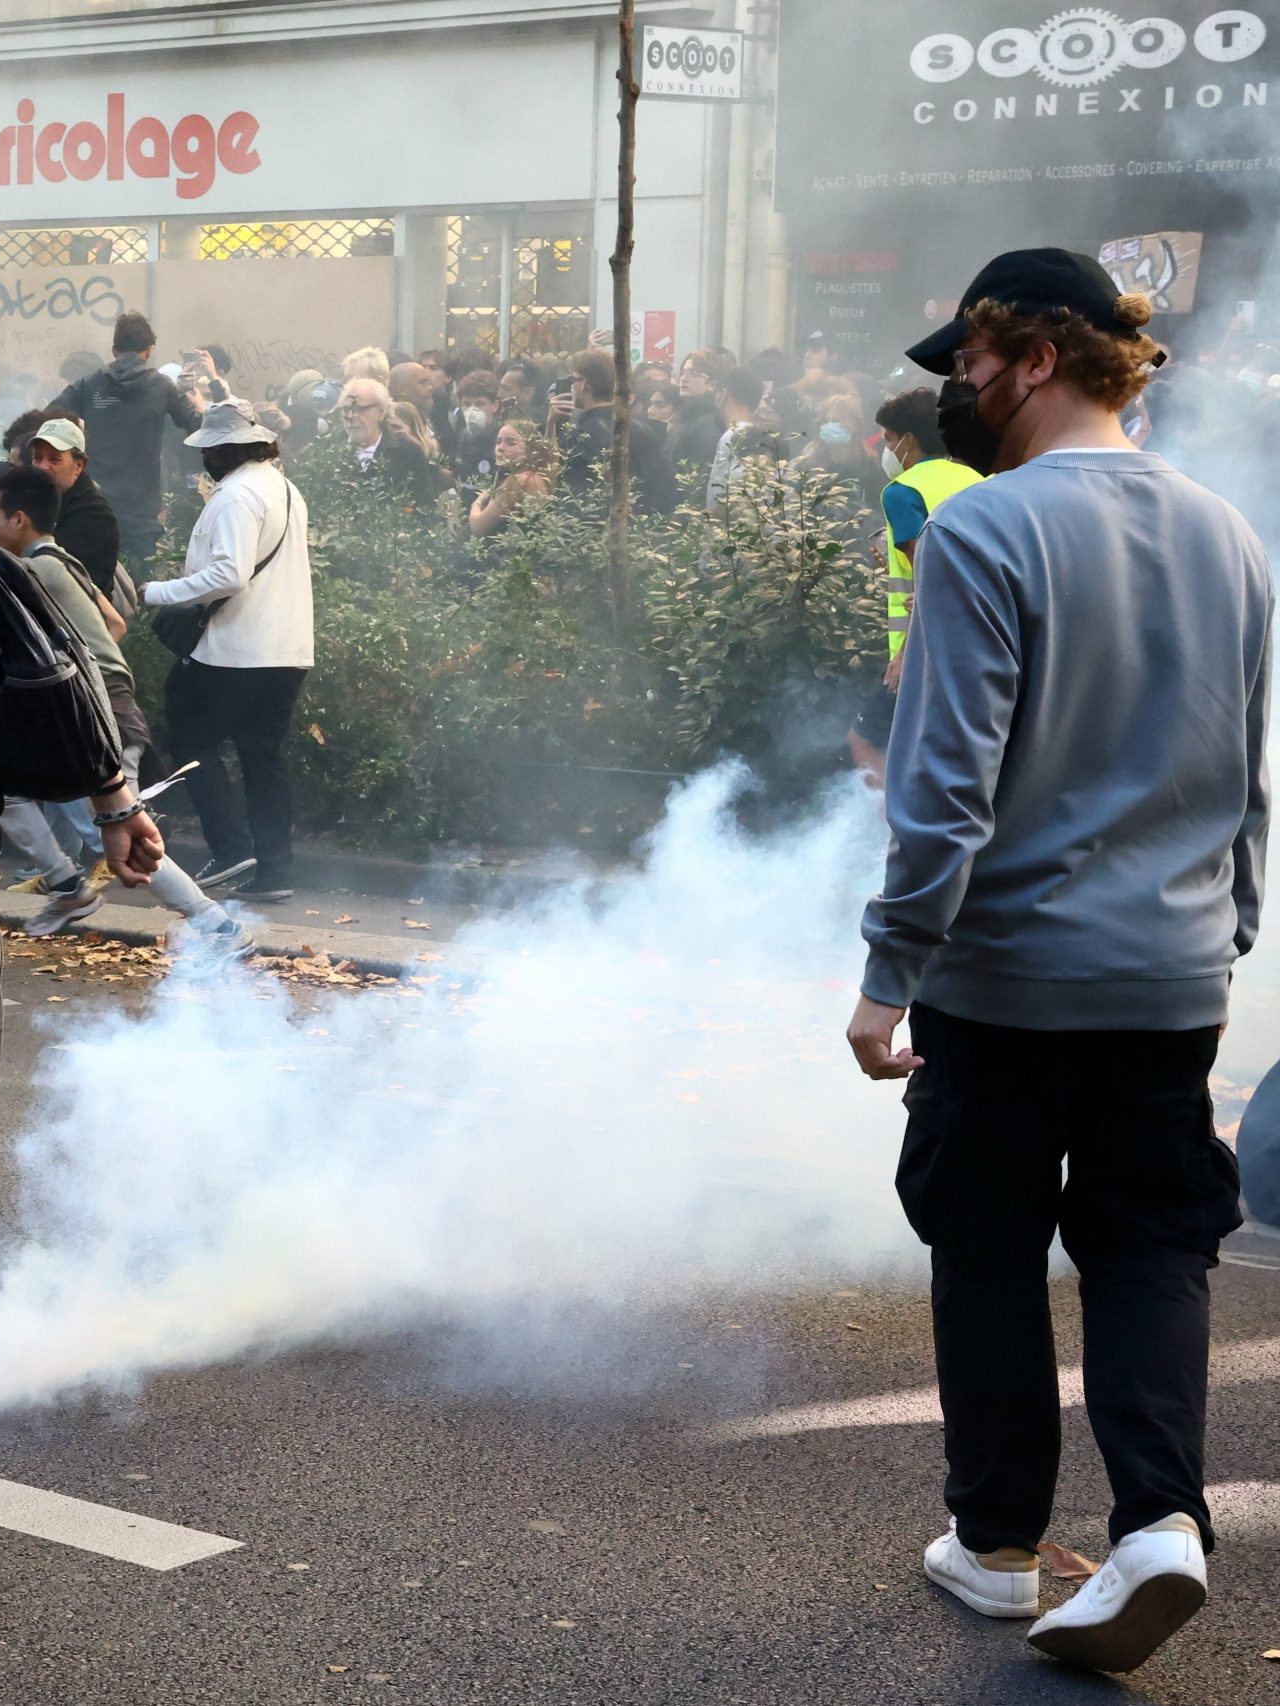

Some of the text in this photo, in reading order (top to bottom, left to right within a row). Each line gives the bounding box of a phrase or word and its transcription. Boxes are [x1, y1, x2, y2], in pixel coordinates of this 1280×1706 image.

[648, 42, 734, 73] SCOOT
[913, 12, 1263, 80] SCOOT
[646, 81, 735, 96] CONNEXION
[913, 82, 1268, 124] CONNEXION
[855, 174, 889, 188] VENTE
[900, 171, 957, 186] ENTRETIEN
[1044, 164, 1116, 180] ACCESSOIRES
[1126, 160, 1183, 176] COVERING
[1195, 158, 1261, 173] EXPERTISE
[815, 282, 882, 296] PLAQUETTES
[829, 306, 865, 319] PNEUS
